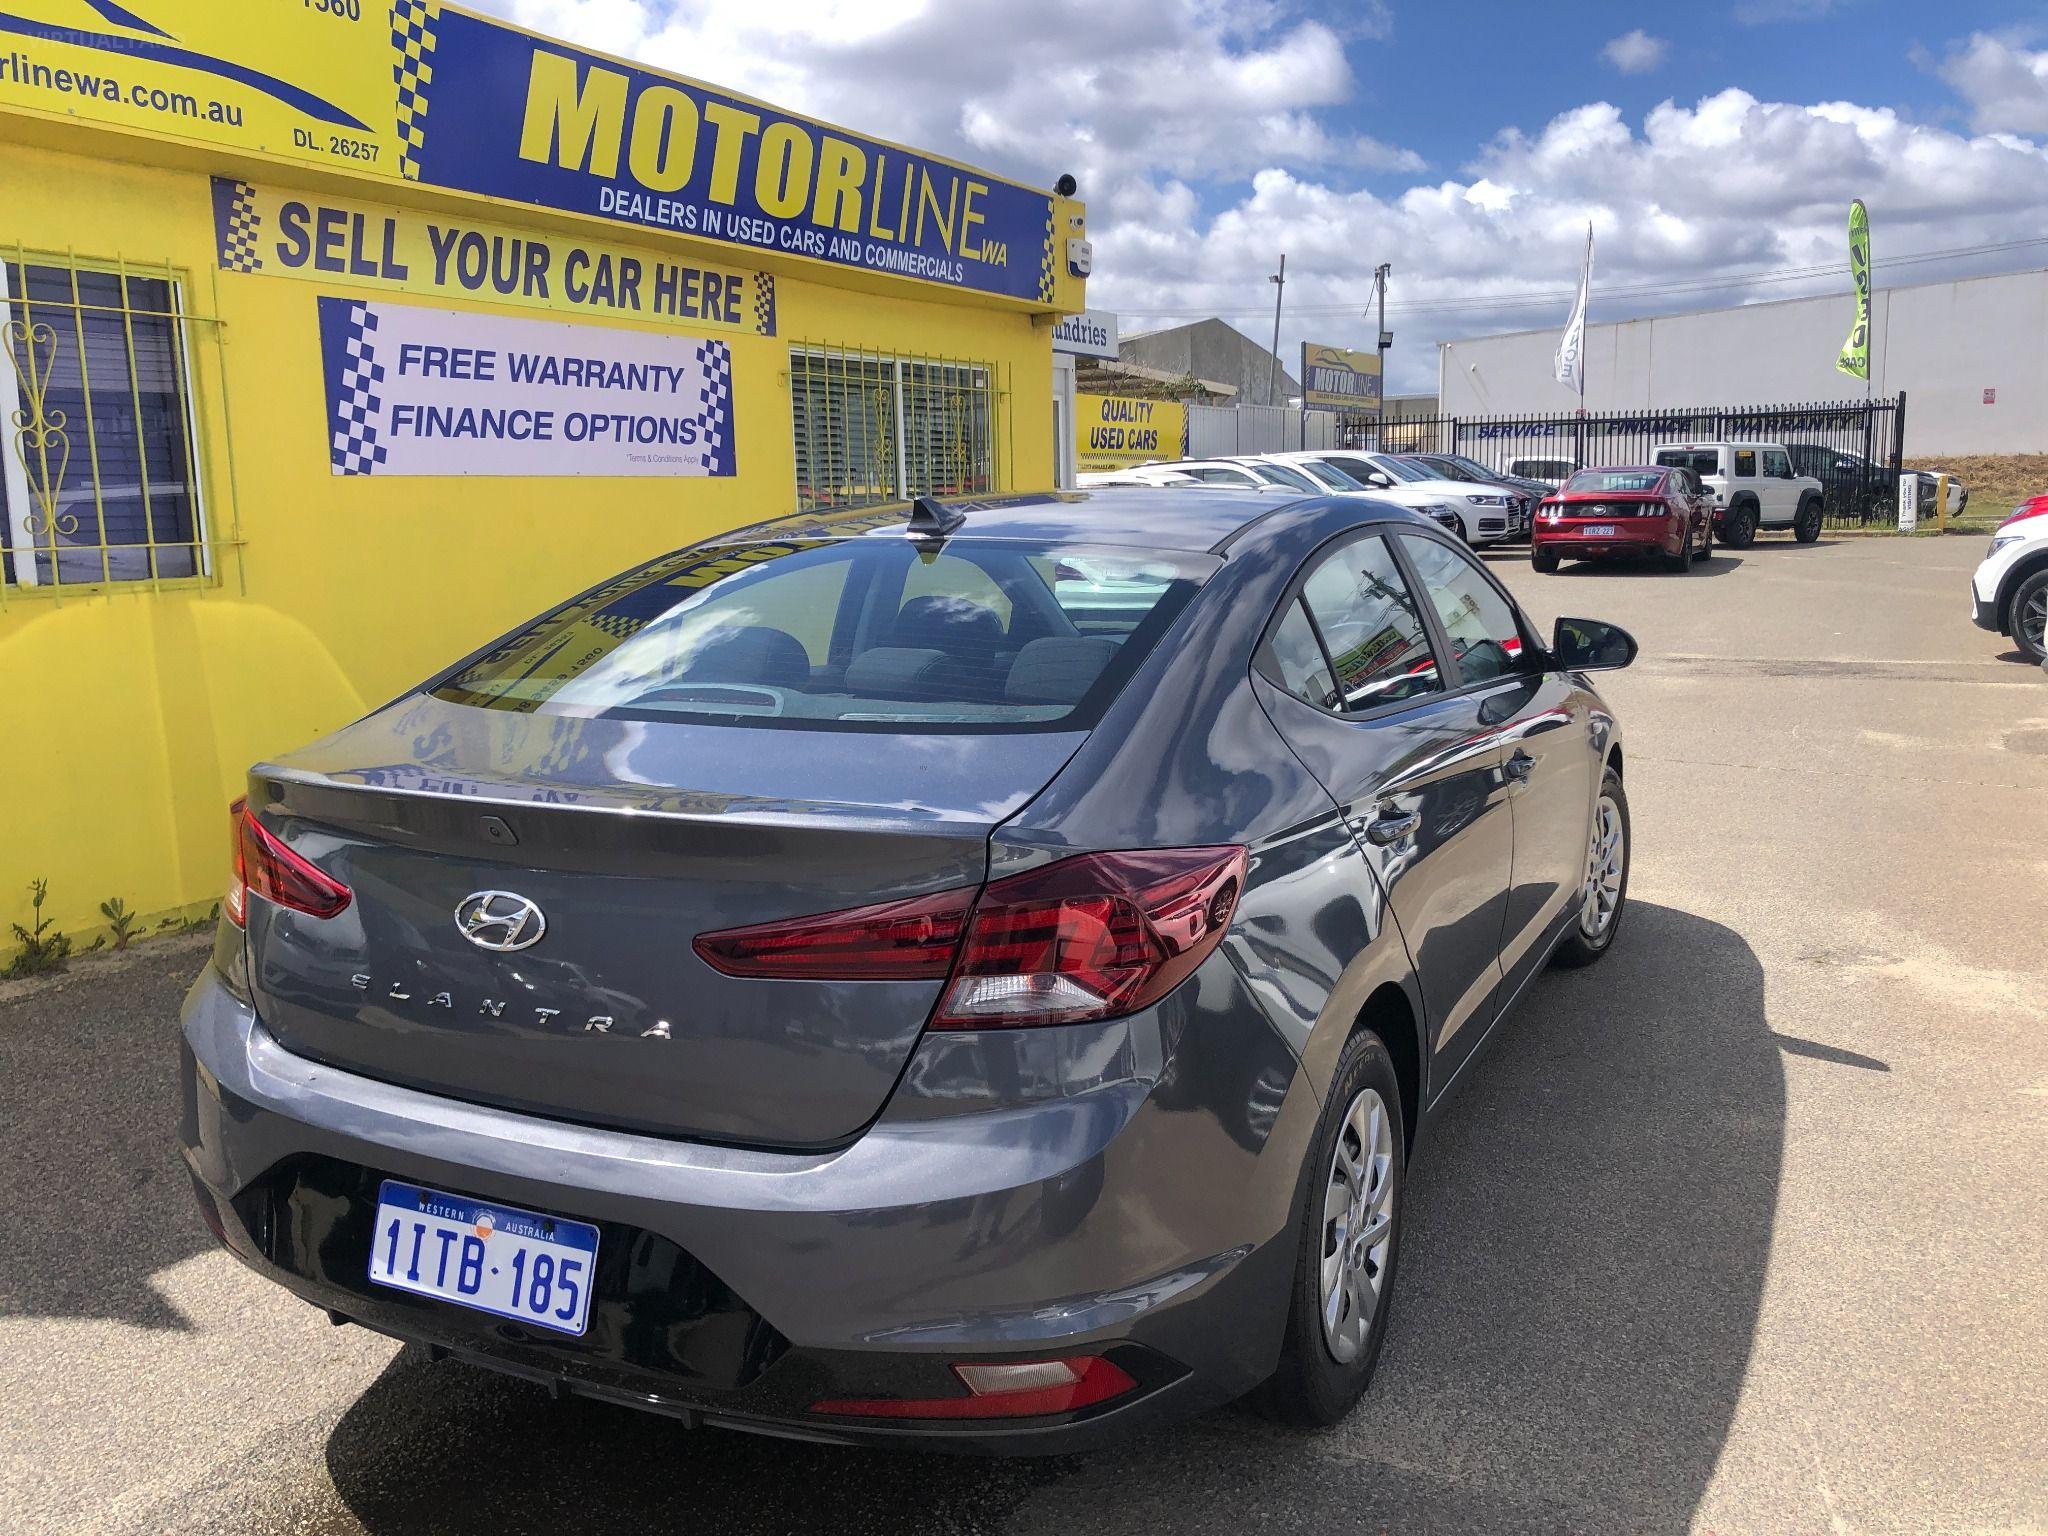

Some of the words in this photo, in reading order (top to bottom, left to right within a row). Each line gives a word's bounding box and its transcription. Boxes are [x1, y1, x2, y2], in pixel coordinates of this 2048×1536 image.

[294, 128, 324, 151] DL.
[329, 136, 379, 162] 26257
[600, 186, 698, 229] DEALERS
[703, 207, 721, 233] IN
[725, 215, 776, 245] USED
[780, 226, 826, 255] CARS
[828, 234, 863, 262] AND
[864, 244, 964, 283] COMMERCIALS
[276, 201, 408, 280] SELL
[427, 225, 551, 299] YOUR
[564, 248, 641, 312] CAR
[653, 270, 744, 324] HERE
[398, 344, 496, 381] FREE
[507, 353, 684, 394] WARRANTY
[391, 405, 553, 440] FINANCE
[563, 412, 697, 445] OPTIONS
[1101, 399, 1154, 423] QUALITY
[1607, 420, 1693, 436] FINANCE
[1732, 414, 1854, 433] WARRANTY
[1090, 427, 1124, 450] USED
[1128, 429, 1158, 450] CARS
[1478, 424, 1556, 439] SERVICE
[351, 974, 672, 1040] ELANTRA
[418, 1203, 464, 1221] WESTERN
[505, 1222, 555, 1242] AUSTRALIA
